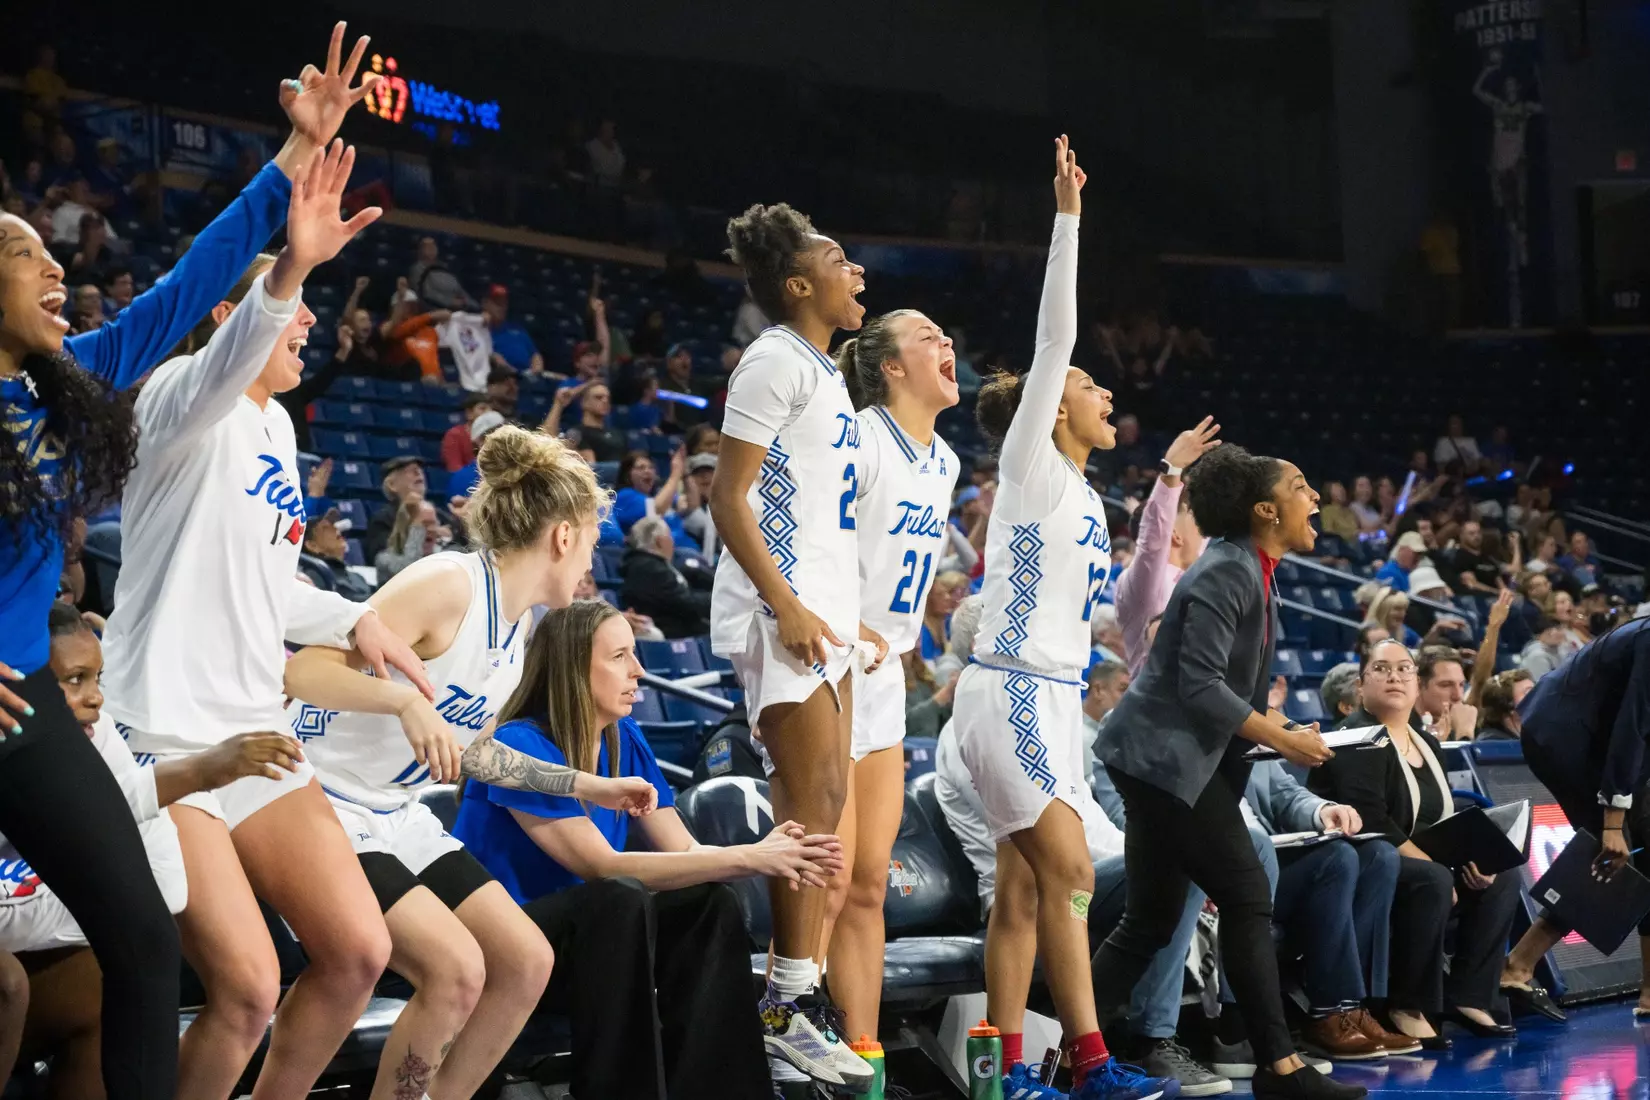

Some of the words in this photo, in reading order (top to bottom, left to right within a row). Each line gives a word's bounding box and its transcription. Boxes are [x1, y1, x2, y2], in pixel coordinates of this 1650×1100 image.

[173, 121, 207, 150] 106
[1613, 291, 1641, 309] 107
[888, 500, 945, 539] Tulsa
[888, 549, 932, 614] 21
[973, 1054, 994, 1079] G
